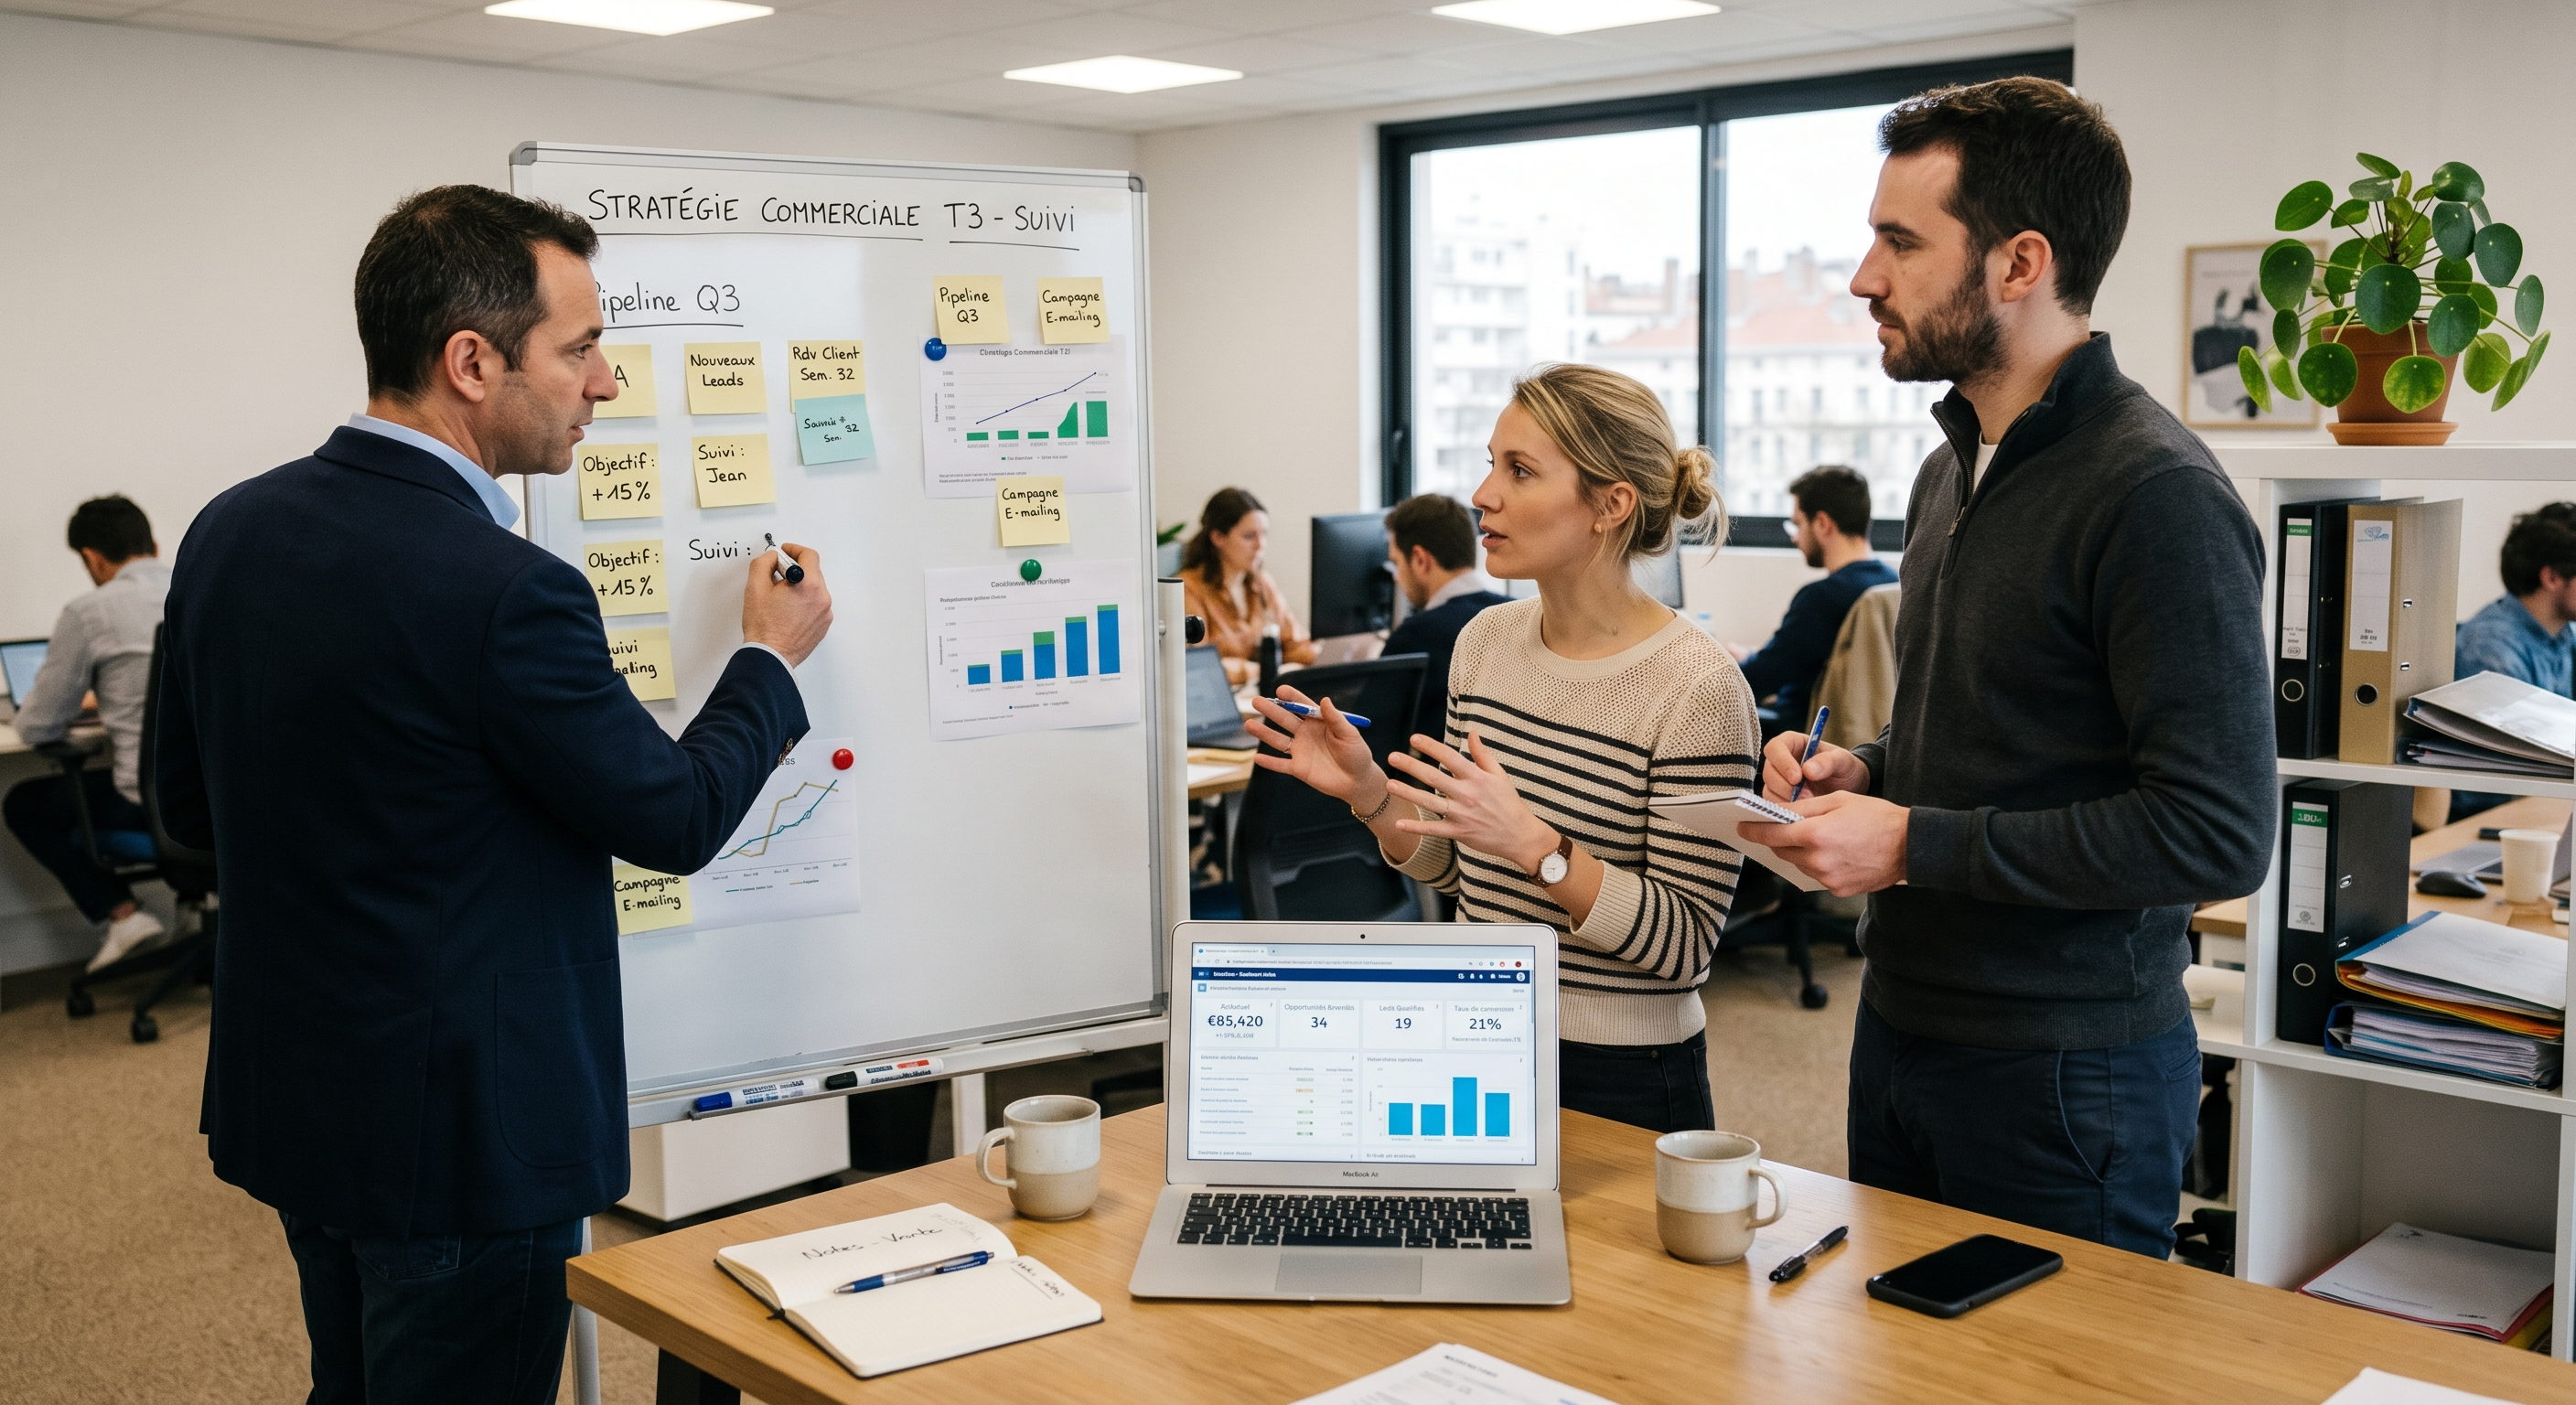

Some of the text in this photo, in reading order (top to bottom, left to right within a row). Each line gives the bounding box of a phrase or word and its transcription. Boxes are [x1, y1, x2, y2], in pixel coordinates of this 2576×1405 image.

[943, 202, 983, 230] T3
[596, 281, 740, 323] ipeline Q3
[939, 286, 990, 309] Pipeline
[1042, 289, 1100, 307] Campagne
[957, 308, 979, 324] Q3
[1046, 309, 1101, 328] E-mailing
[690, 353, 756, 367] Nouveaux
[792, 345, 861, 360] Rdv Client
[702, 371, 744, 387] Leads
[800, 367, 855, 381] Sem. 32
[698, 444, 735, 460] Suivi
[705, 467, 747, 484] Jean
[1002, 488, 1059, 504] Campagne
[1004, 504, 1061, 521] E-mailing
[688, 538, 738, 561] Suivi
[611, 639, 639, 655] uivi
[613, 876, 681, 896] Campagne
[623, 894, 682, 912] E-mailing
[1207, 1014, 1263, 1029] €85,420
[1311, 1016, 1328, 1028] 34
[1395, 1017, 1411, 1029] 19
[1469, 1018, 1502, 1030] 21%
